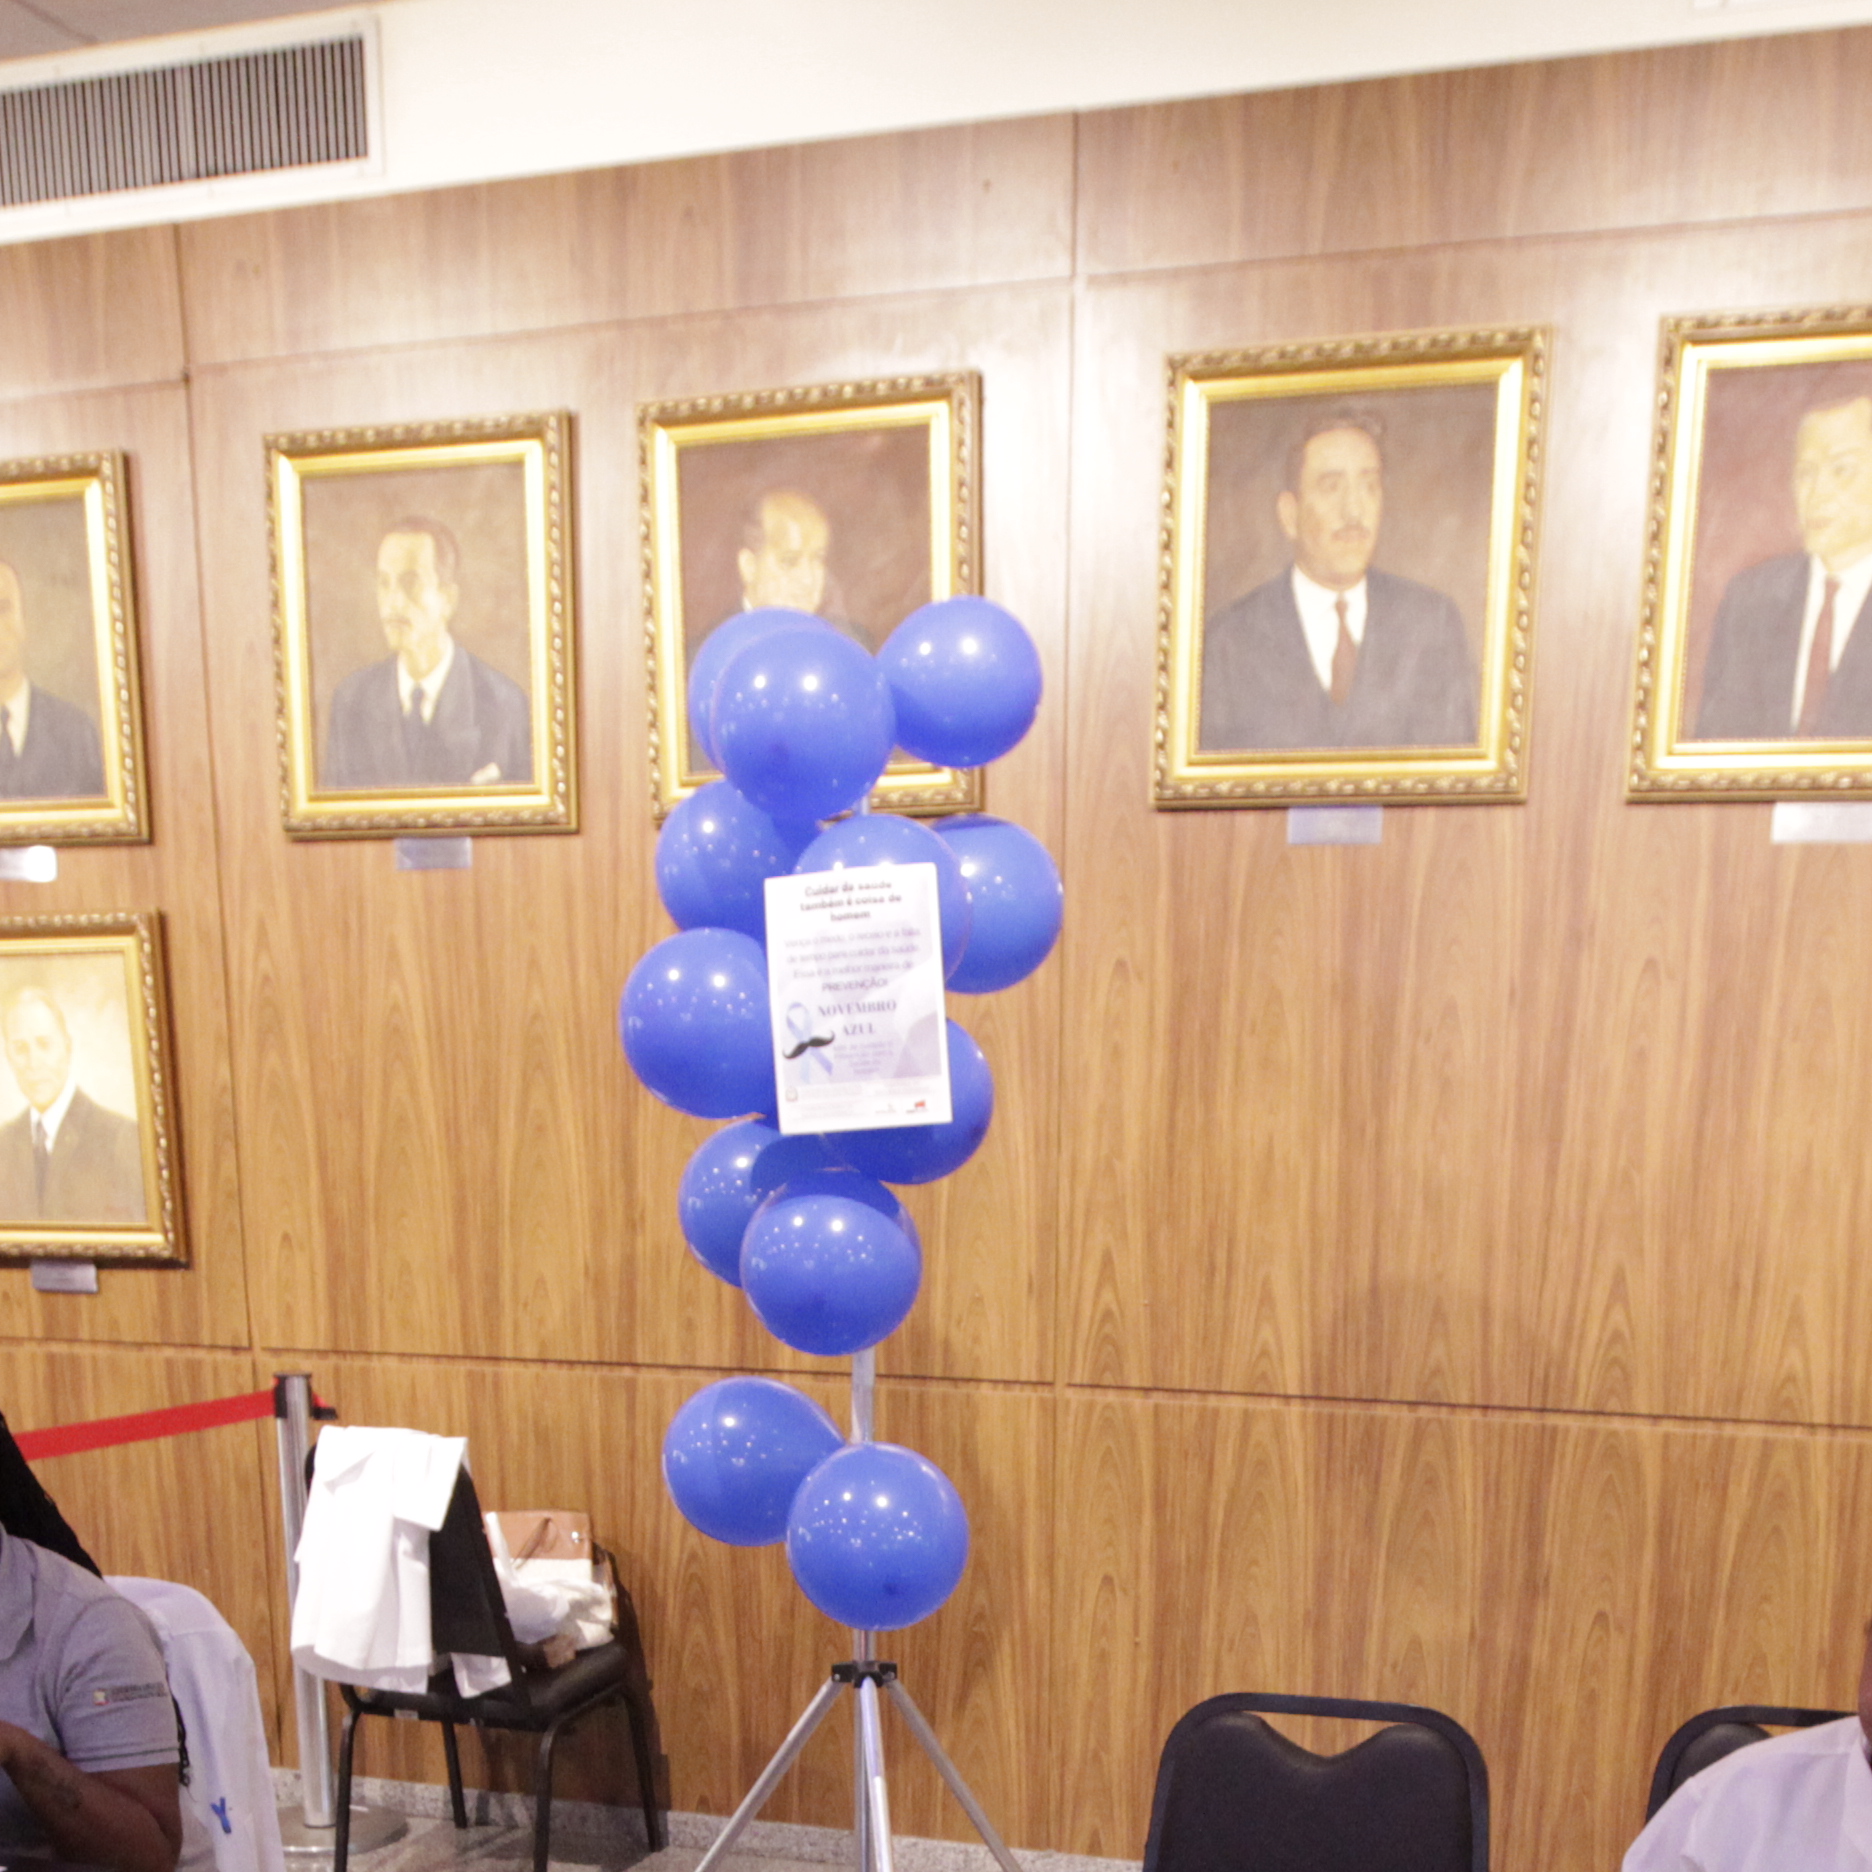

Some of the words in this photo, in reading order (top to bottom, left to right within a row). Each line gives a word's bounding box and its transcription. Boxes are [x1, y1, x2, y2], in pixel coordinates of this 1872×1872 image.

[800, 898, 844, 912] também
[830, 911, 871, 922] homem
[818, 1000, 897, 1017] NOVEMBRO
[843, 1022, 875, 1036] AZUL
